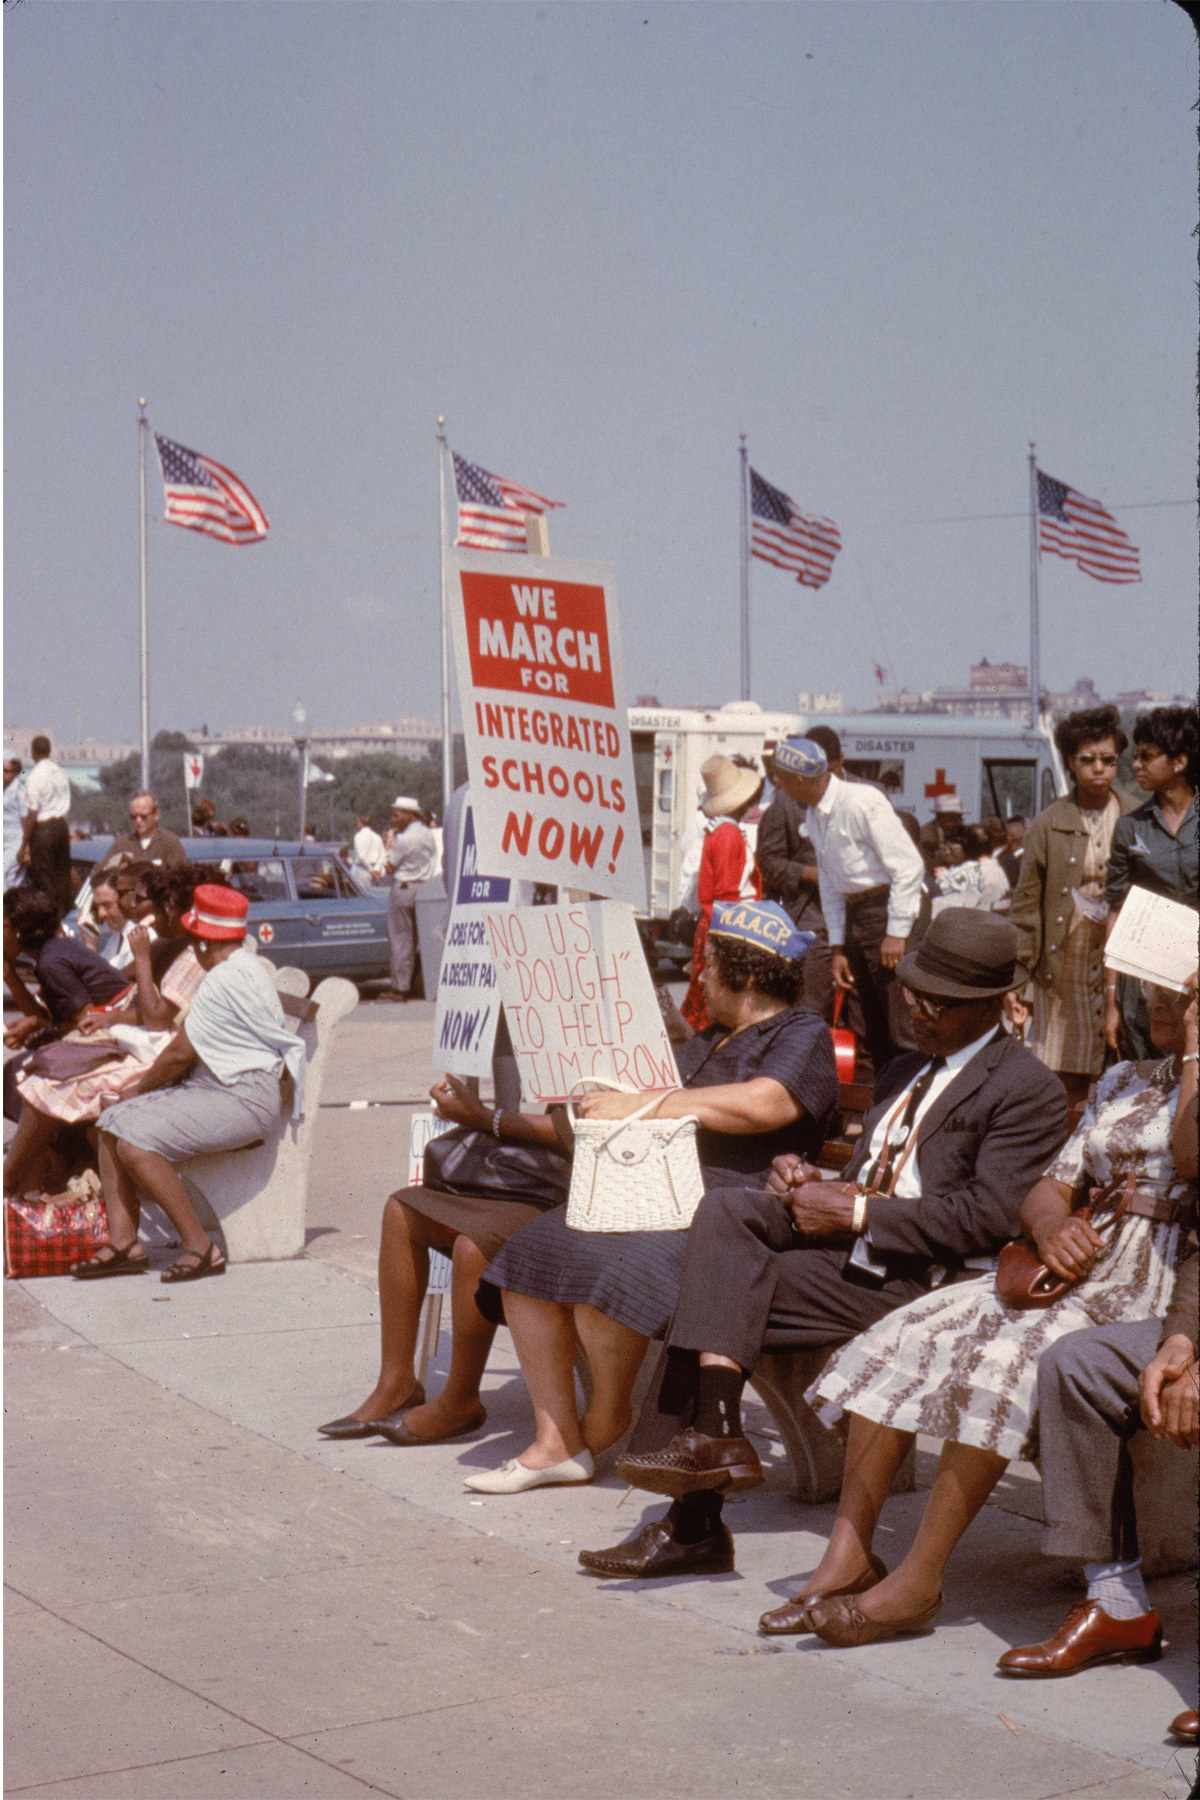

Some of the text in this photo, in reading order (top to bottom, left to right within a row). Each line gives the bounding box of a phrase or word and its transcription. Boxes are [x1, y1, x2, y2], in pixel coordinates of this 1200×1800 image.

[511, 584, 558, 621] WE
[479, 617, 602, 673] MARCH
[520, 667, 570, 694] FOR
[475, 701, 621, 759] INTEGRATED
[631, 715, 681, 728] DISASTER
[855, 740, 915, 753] DISASTER
[482, 755, 626, 814] SCHOOLS
[501, 810, 625, 875] NOW!
[470, 880, 491, 898] FOR
[448, 921, 486, 947] JOBS FOR
[487, 912, 527, 958] NO
[719, 910, 792, 946] N.A.A.C.P.
[441, 962, 448, 986] A
[449, 962, 480, 987] DECENT
[503, 951, 630, 1002] "DOUGH"
[440, 1005, 490, 1051] NOW!
[507, 1001, 633, 1049] TO HELP
